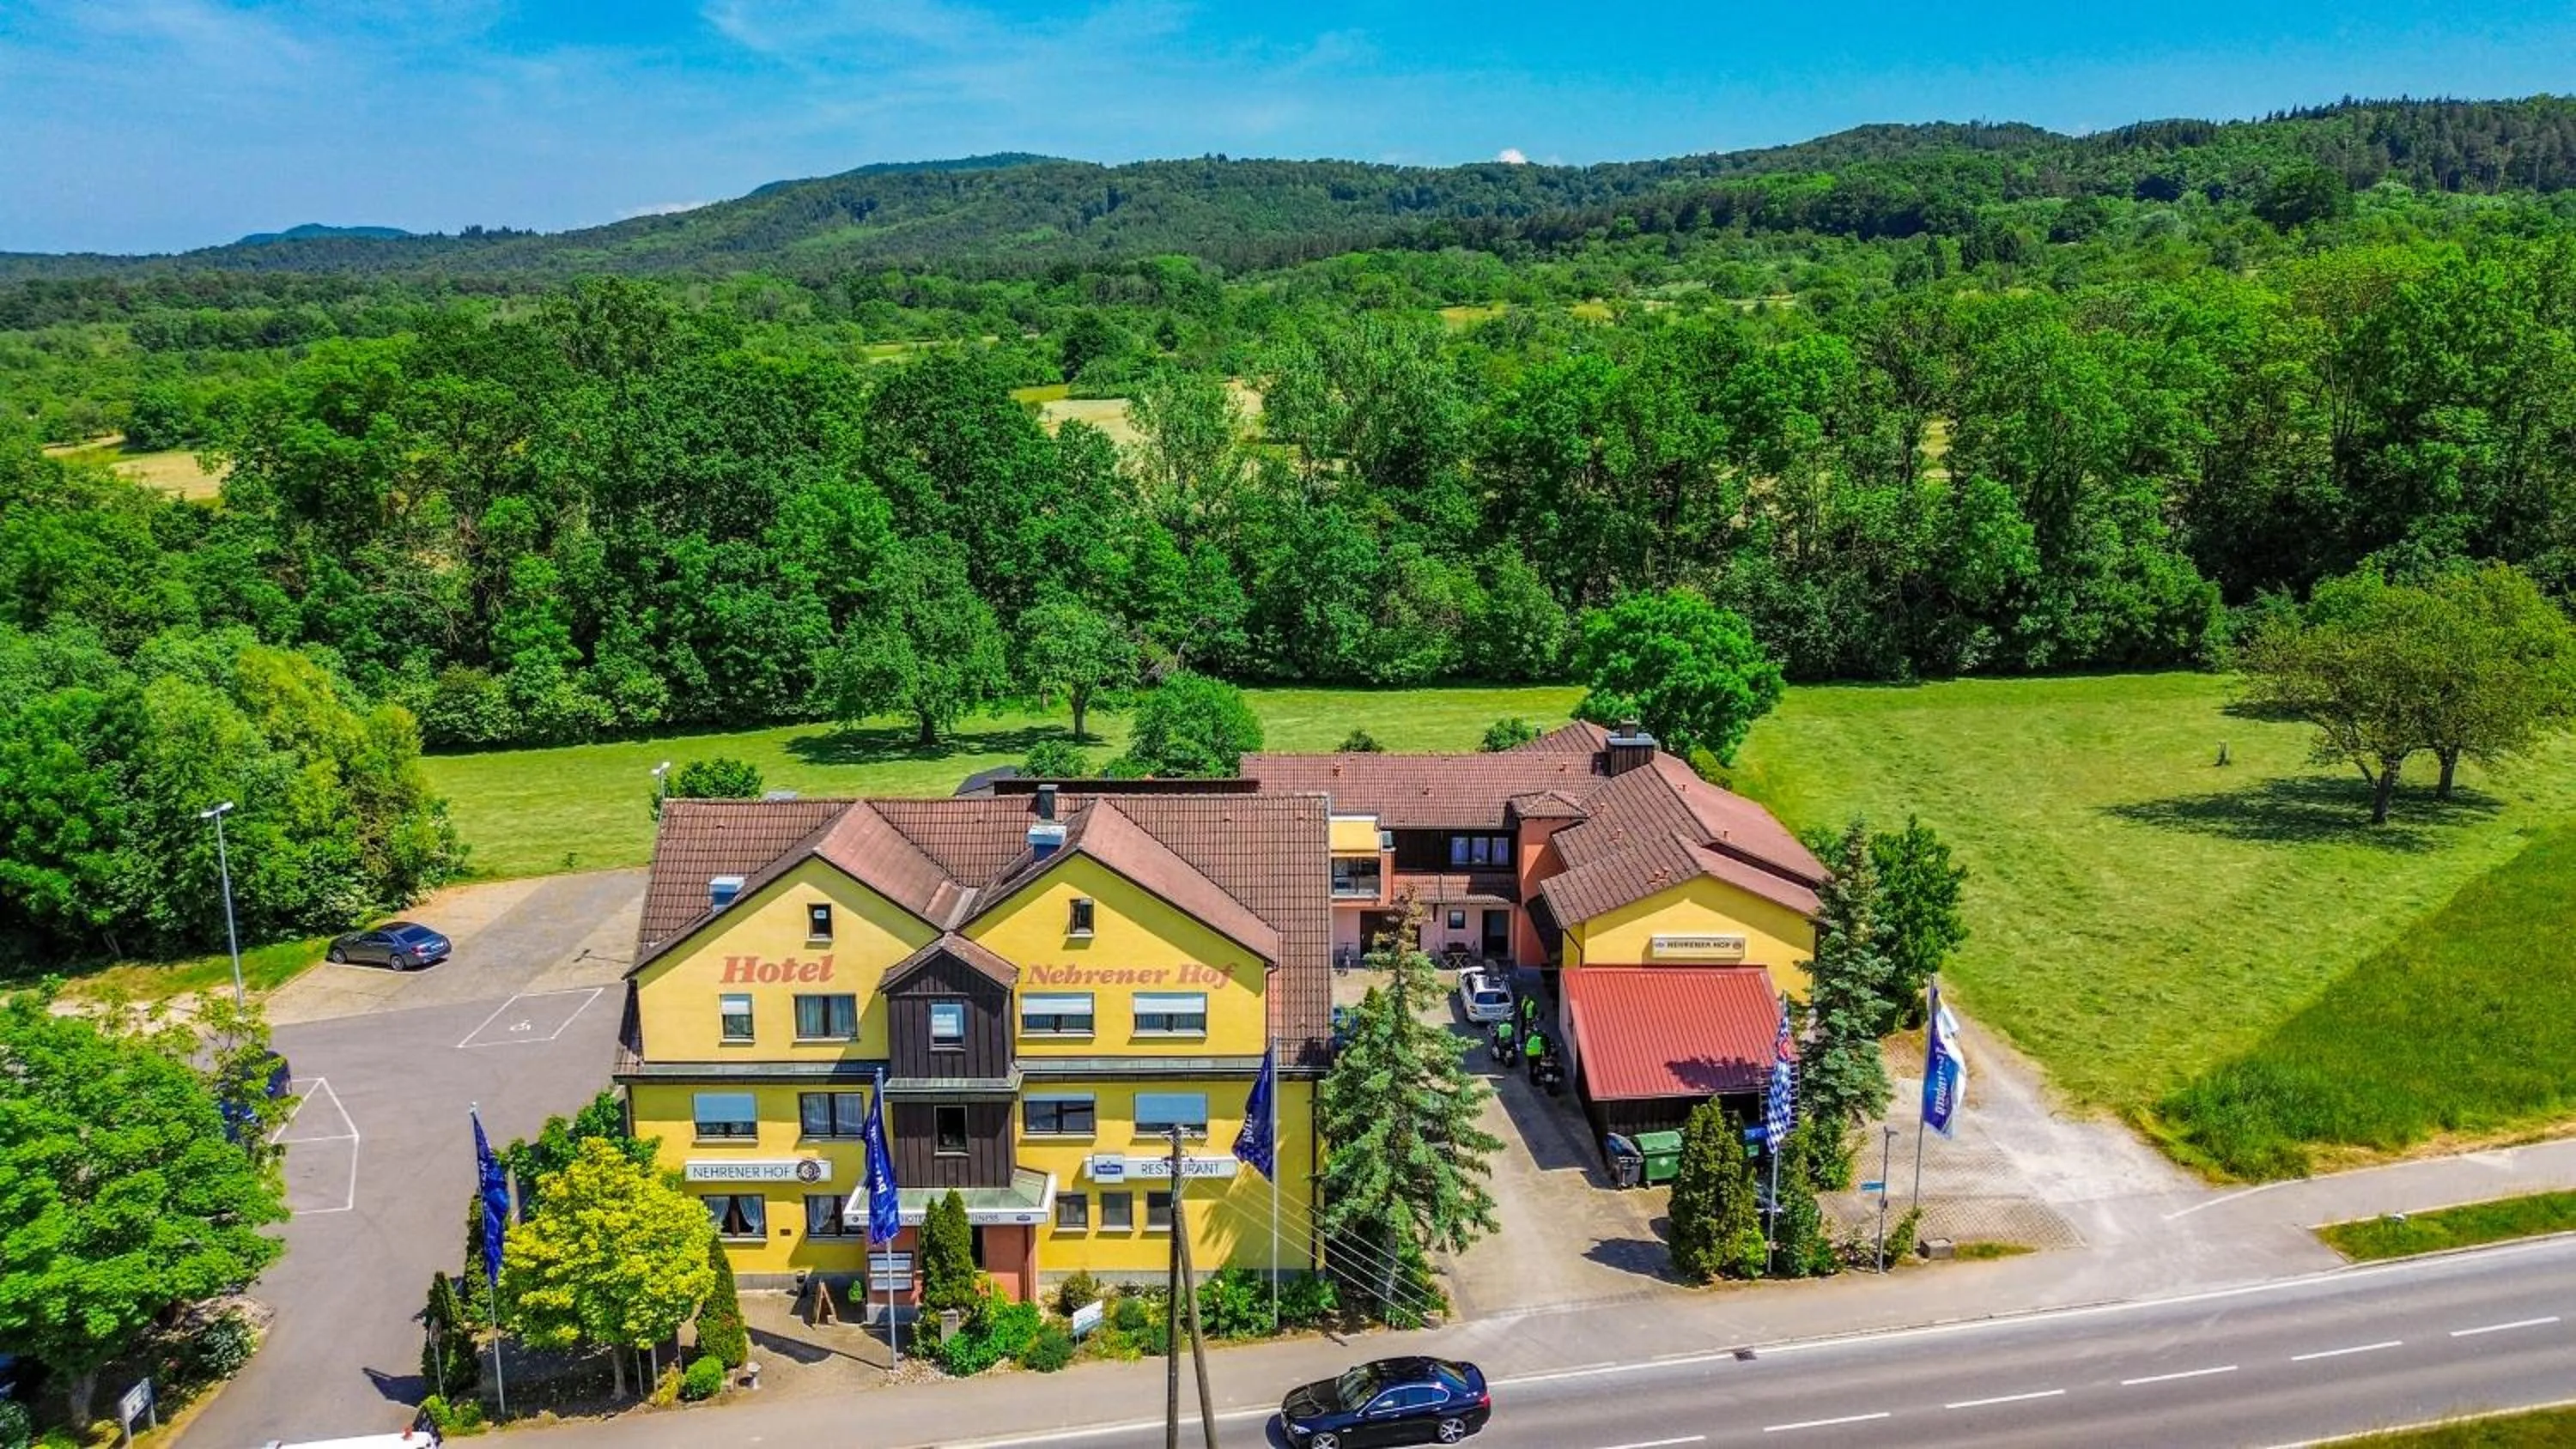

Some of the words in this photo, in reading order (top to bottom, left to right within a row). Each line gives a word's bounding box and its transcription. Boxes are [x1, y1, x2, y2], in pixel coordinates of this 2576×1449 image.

[720, 955, 835, 985] Hotel
[1029, 963, 1169, 985] Nehrener
[1176, 962, 1238, 989] Hof
[693, 1167, 760, 1179] NEHRENER
[763, 1167, 791, 1179] HOF
